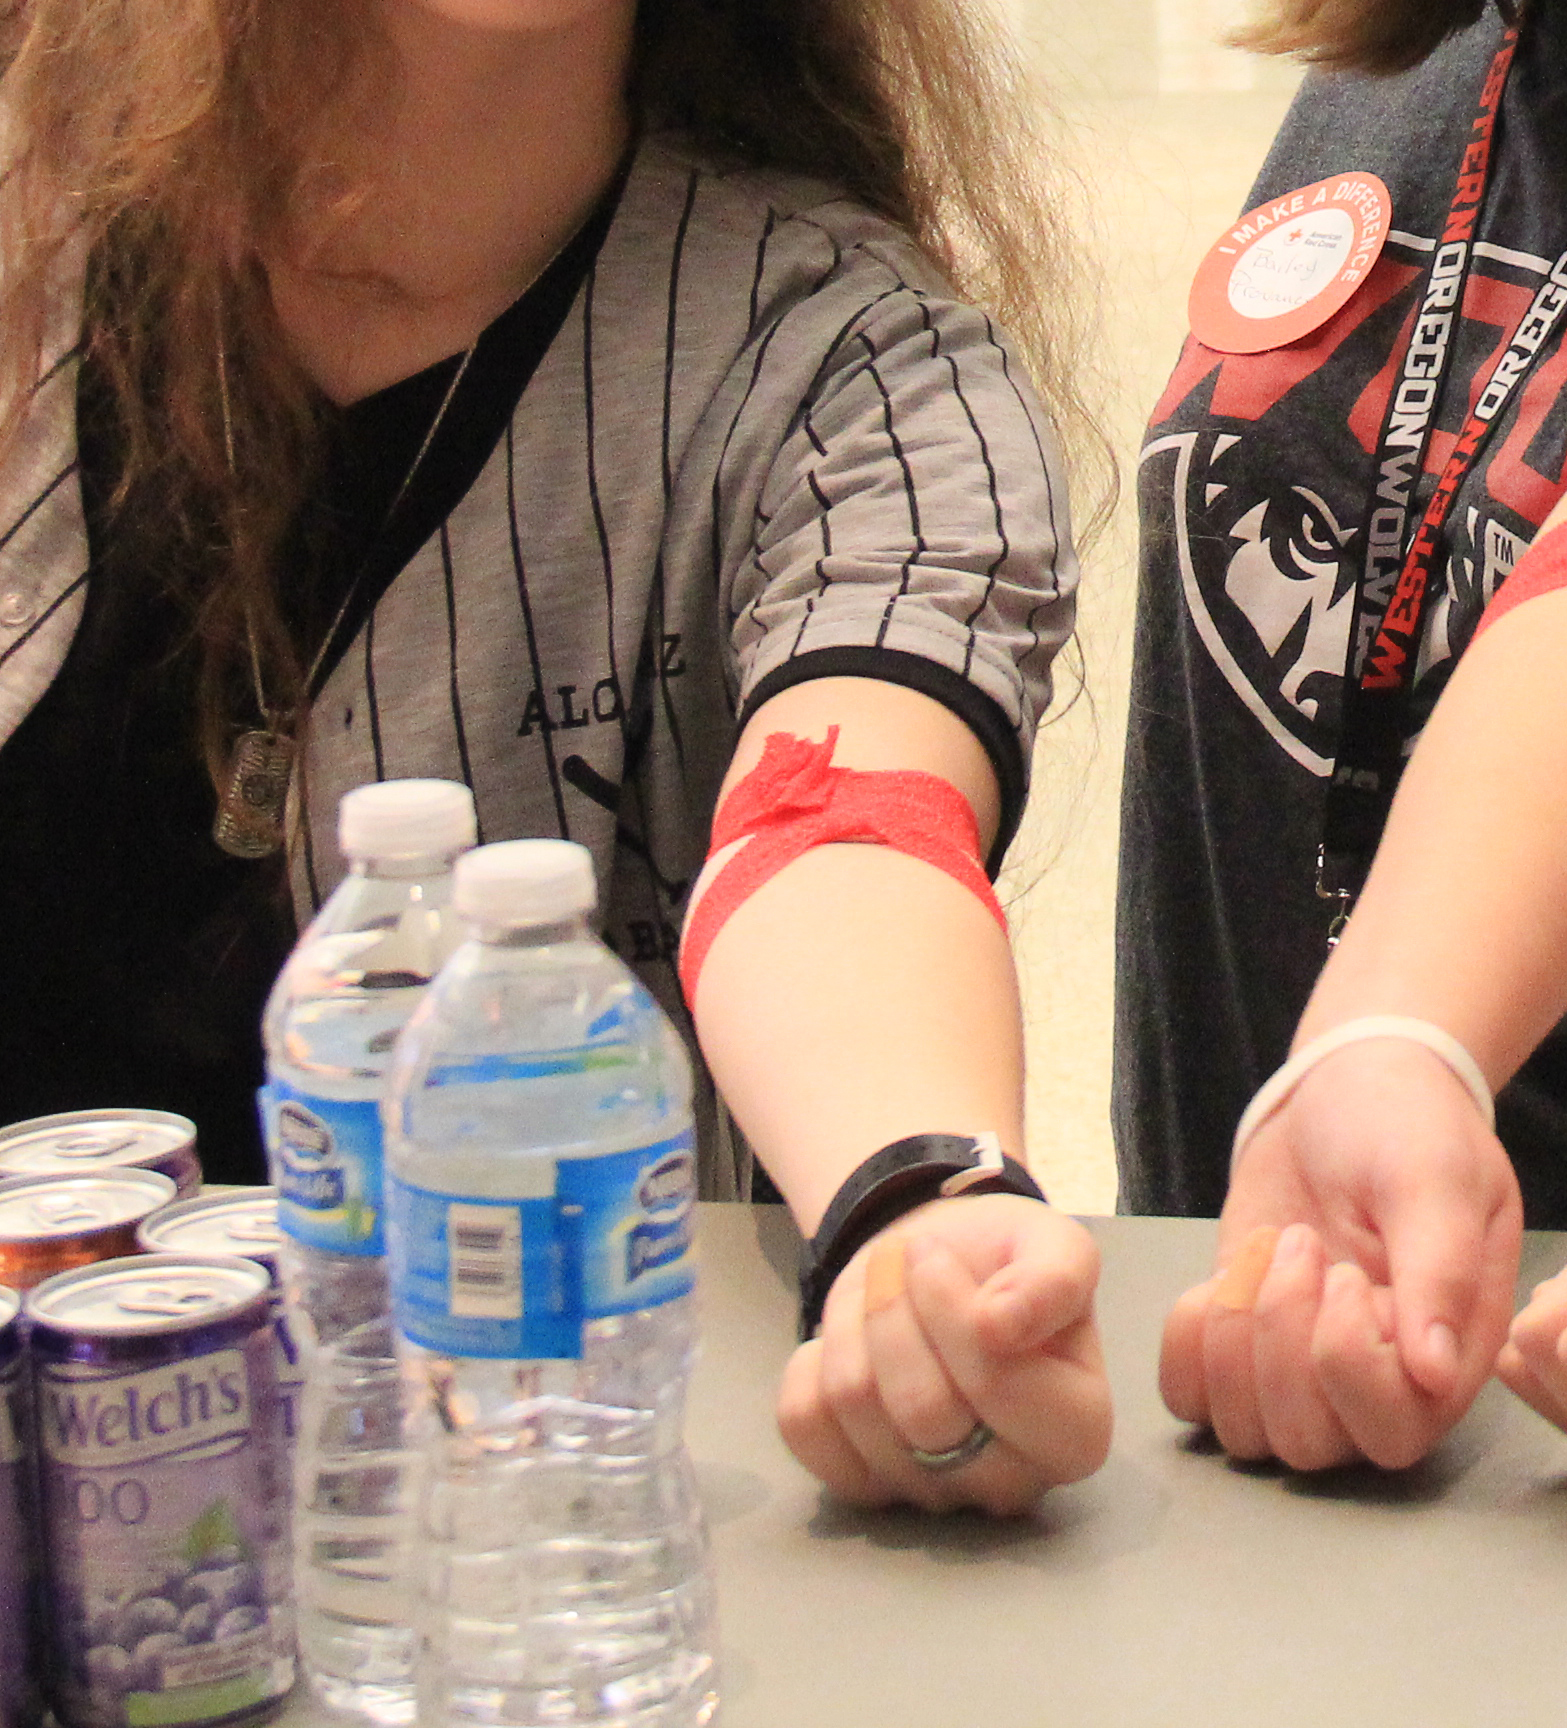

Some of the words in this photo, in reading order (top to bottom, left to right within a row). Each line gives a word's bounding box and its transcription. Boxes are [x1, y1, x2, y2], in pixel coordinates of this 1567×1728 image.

[1218, 246, 1236, 254] I
[1232, 195, 1304, 244] MAKE
[1312, 187, 1326, 205] A
[1332, 180, 1382, 282] DIFFERENCE
[1304, 238, 1317, 246] Red
[1317, 240, 1338, 248] Cross
[1310, 231, 1343, 240] American
[1384, 240, 1468, 450] OREGON
[1353, 449, 1420, 678] WOLVE
[1361, 418, 1489, 689] WESTERN
[1493, 532, 1514, 566] TM
[50, 1367, 242, 1447] Welch's
